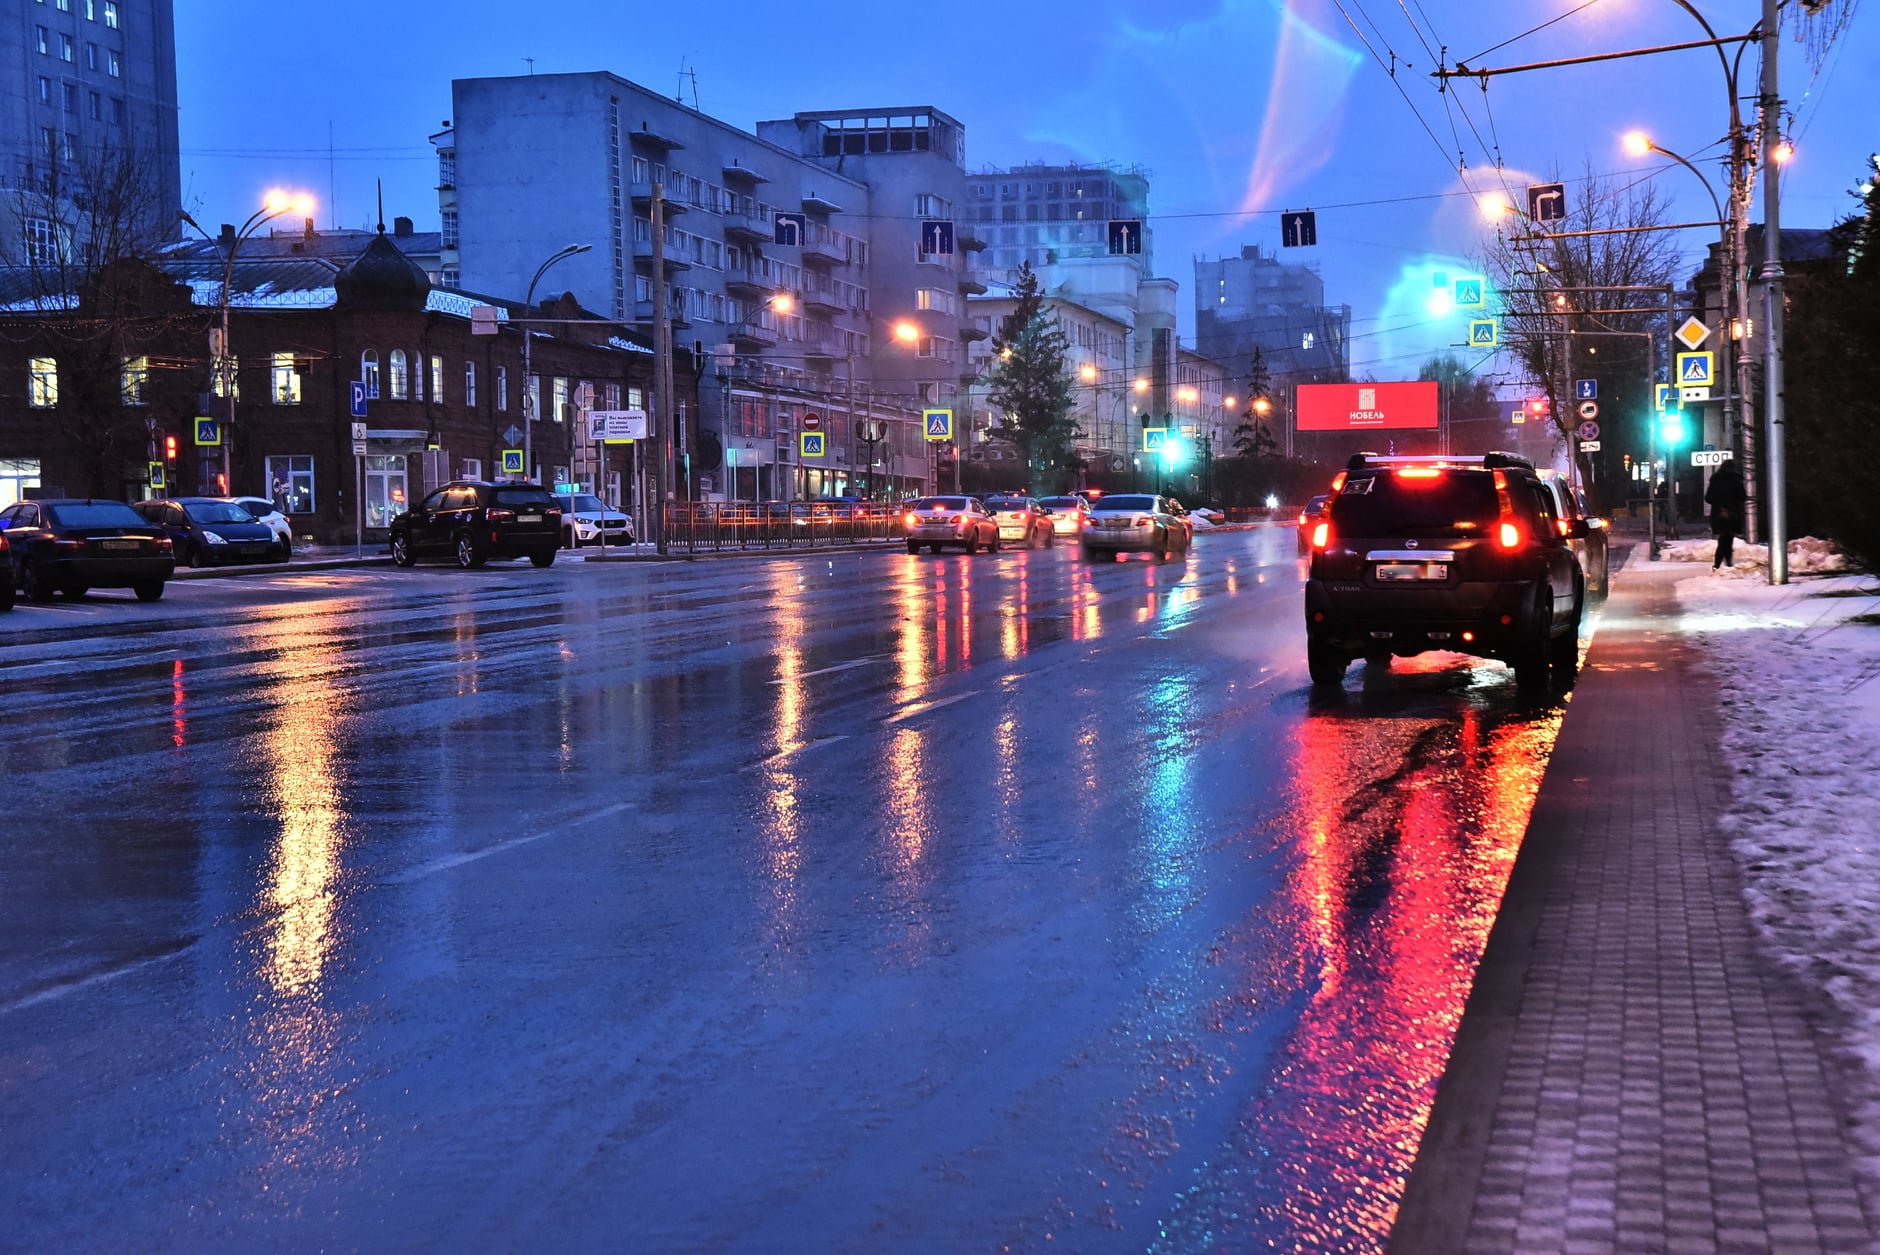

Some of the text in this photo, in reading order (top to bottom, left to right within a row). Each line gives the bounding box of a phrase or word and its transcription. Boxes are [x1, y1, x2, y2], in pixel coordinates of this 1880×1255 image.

[354, 386, 363, 411] P
[1349, 411, 1384, 420] НОБЕЛЬ
[1695, 453, 1729, 464] СТОП
